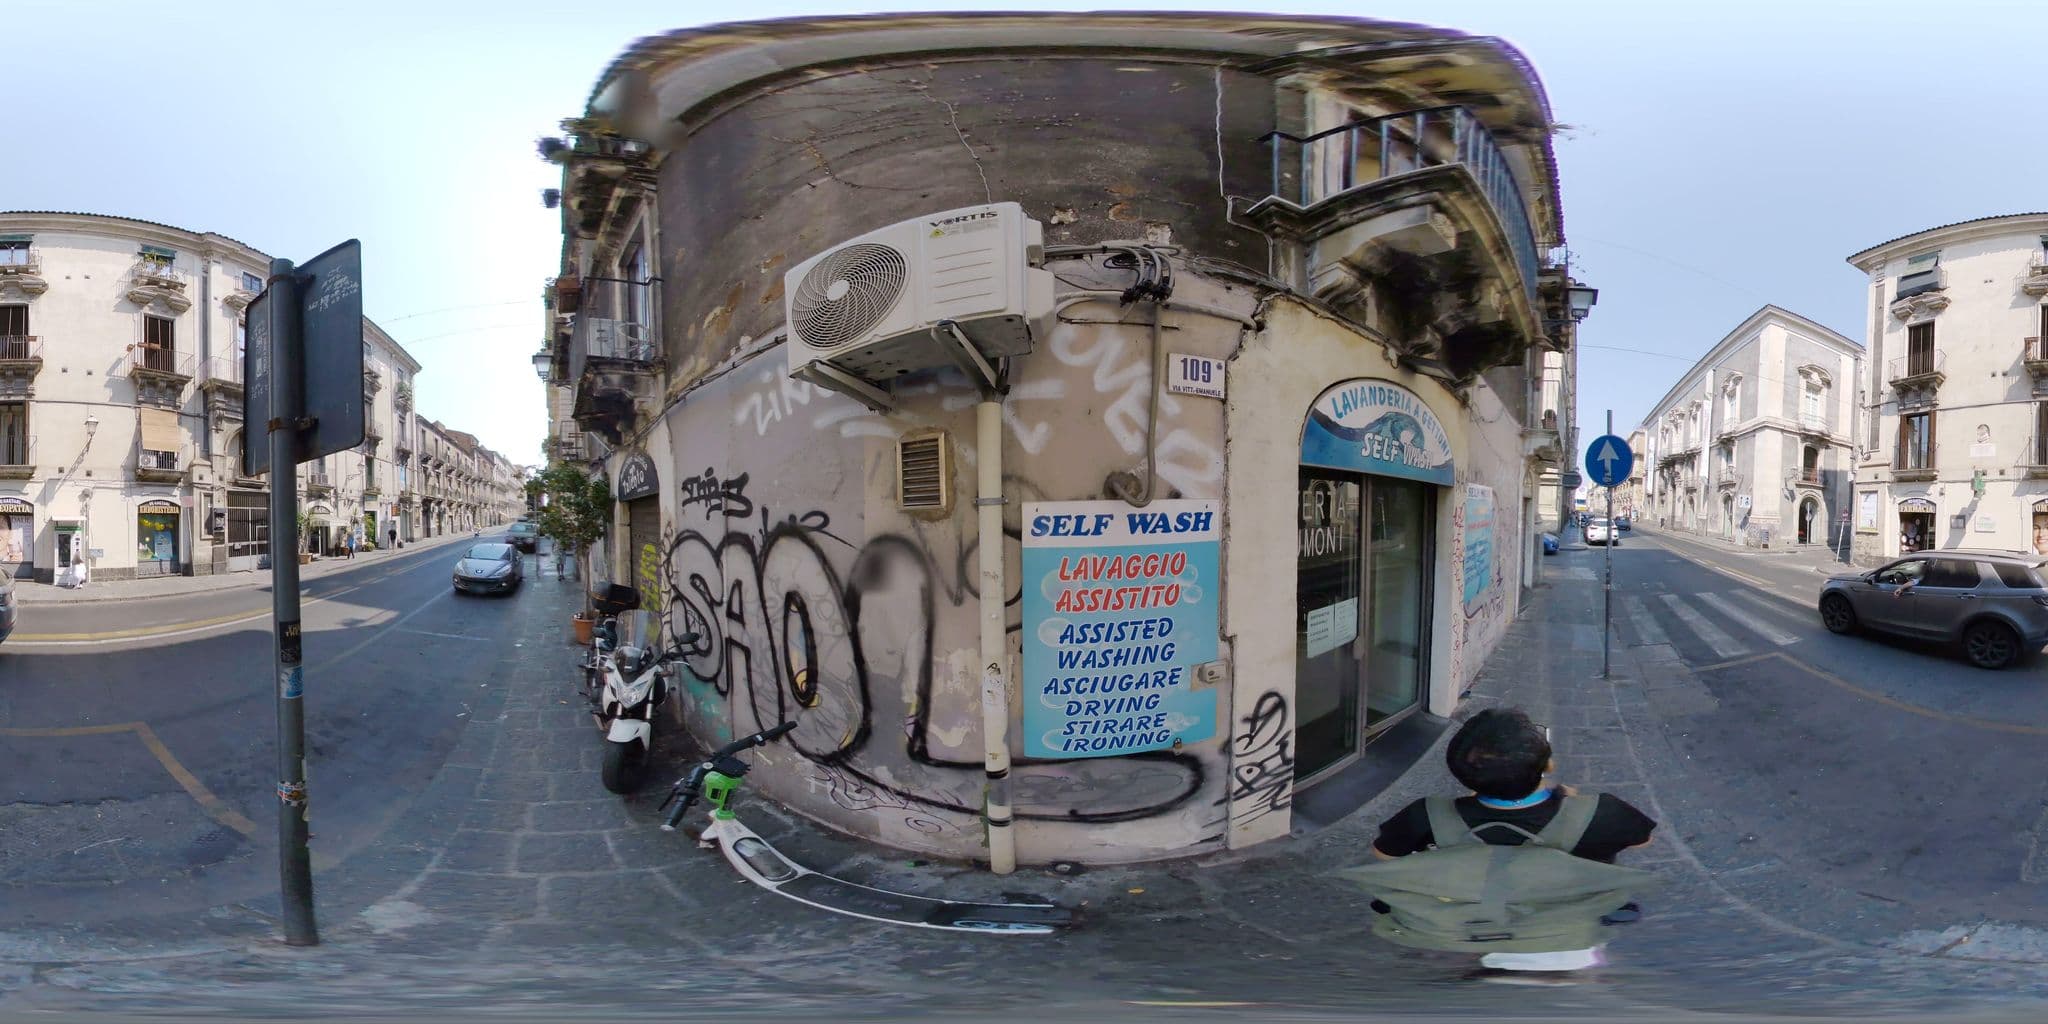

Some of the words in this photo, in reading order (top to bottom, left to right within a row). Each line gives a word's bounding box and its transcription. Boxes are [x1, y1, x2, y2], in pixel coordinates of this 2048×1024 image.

[1181, 357, 1211, 383] 109
[1172, 384, 1181, 392] VIA
[1331, 385, 1412, 419] LAVANDERIA
[1413, 404, 1421, 417] A
[1421, 410, 1450, 457] GETTONI
[1361, 432, 1399, 462] SELF
[1031, 514, 1114, 537] SELF
[1127, 511, 1213, 535] WASH
[1058, 552, 1187, 581] LAVAGGIO
[1055, 584, 1182, 612] ASSISTITO
[1059, 617, 1174, 645] ASSISTED
[1058, 642, 1175, 669] WASHING
[1043, 667, 1182, 695] ASCIUGARE
[1065, 693, 1160, 717] DRYING
[1062, 712, 1168, 736] STIRARE
[1062, 729, 1171, 752] IRONING
